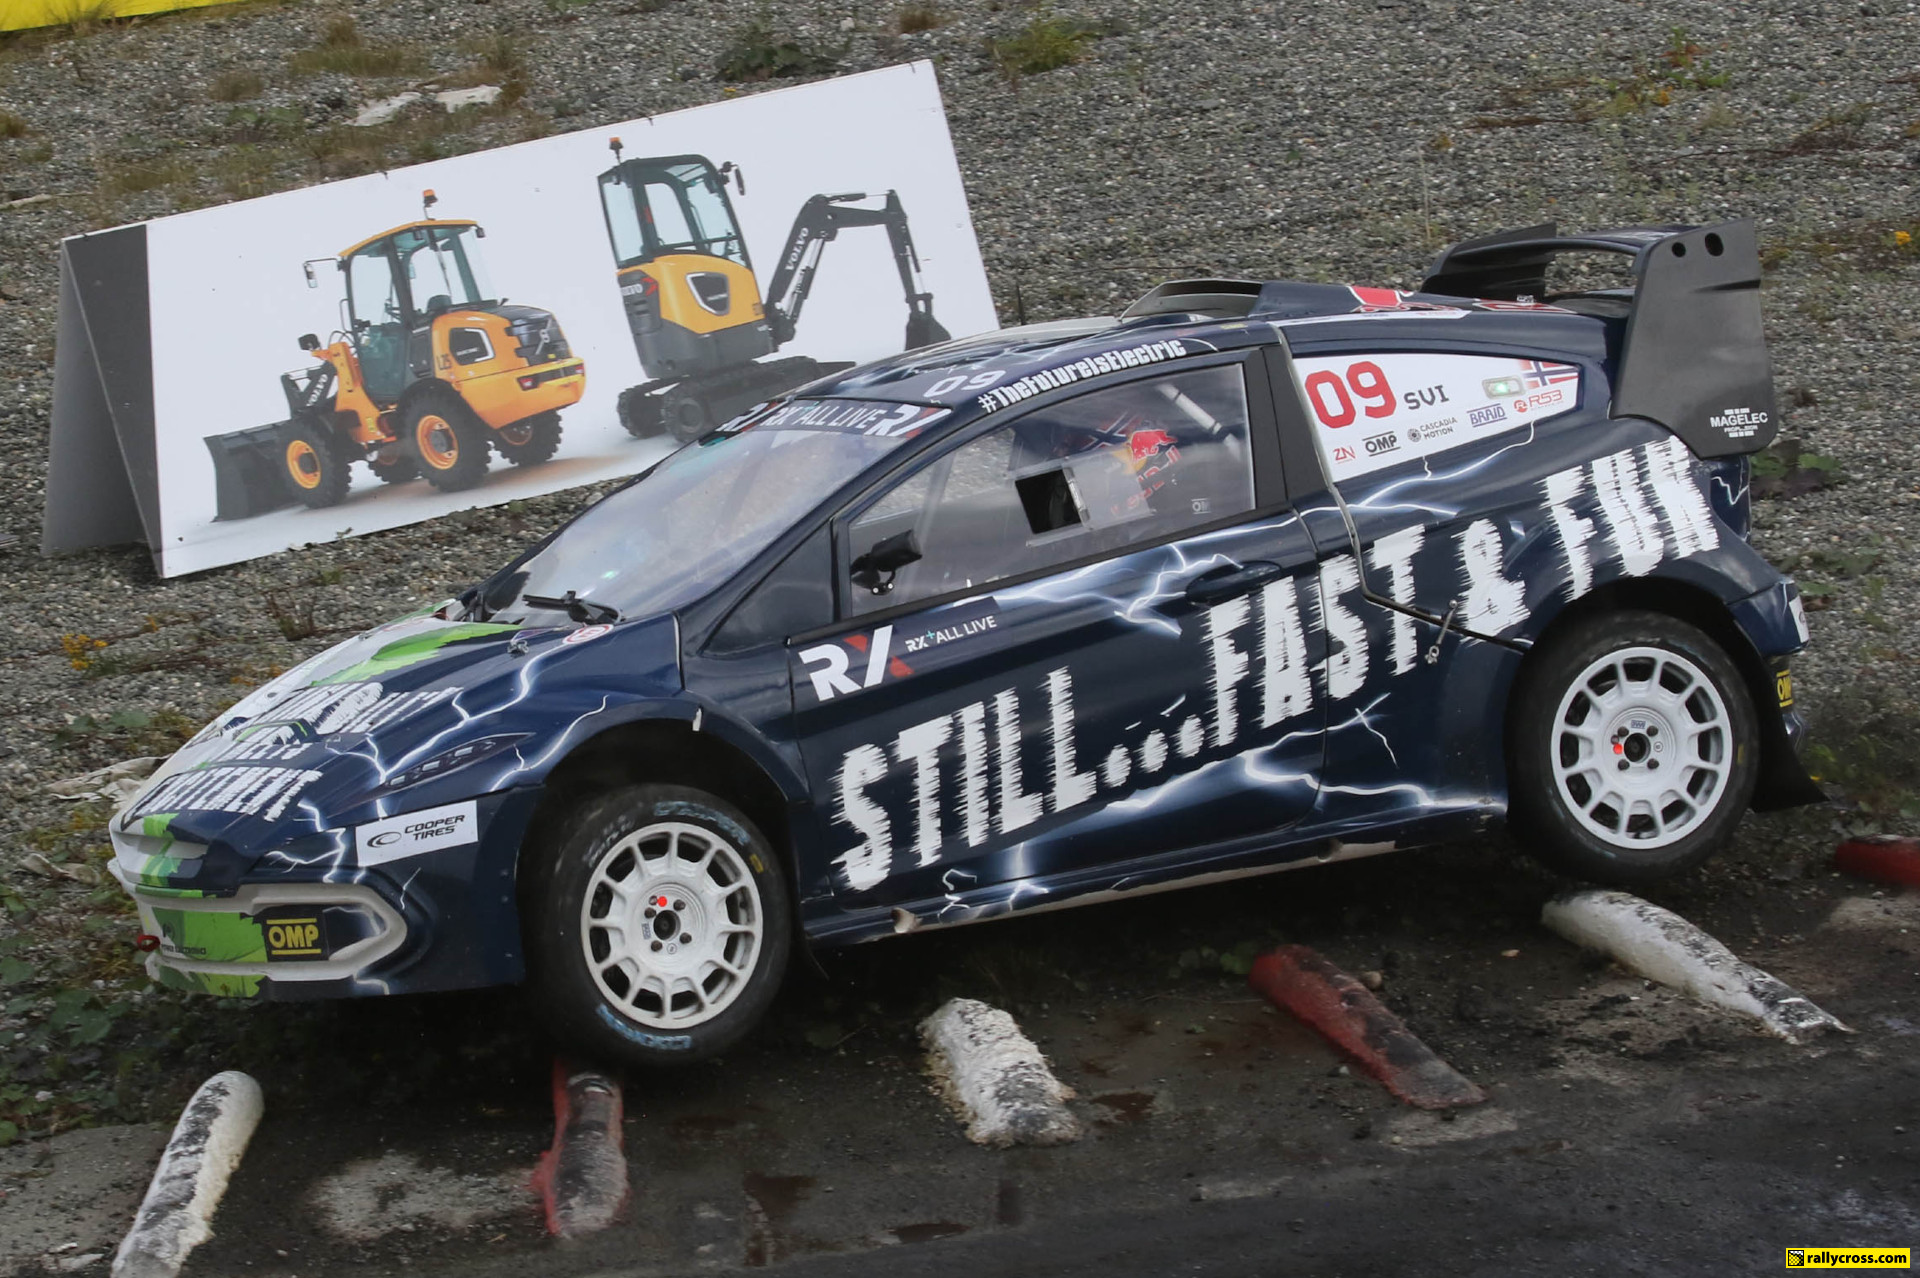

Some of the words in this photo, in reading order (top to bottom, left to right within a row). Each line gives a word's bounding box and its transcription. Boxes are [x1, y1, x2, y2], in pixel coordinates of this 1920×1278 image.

[784, 227, 809, 271] VOLVO
[923, 369, 1007, 398] 09
[977, 338, 1188, 414] #TheFutureIsElectric
[306, 374, 329, 407] VOLVO
[1304, 361, 1397, 429] 09
[1404, 384, 1450, 410] SVI
[1419, 416, 1458, 433] CASCADIA
[1470, 406, 1507, 426] BRAID
[1709, 412, 1769, 428] MAGELEC
[1364, 433, 1398, 453] OMP
[1423, 426, 1454, 441] MOTION
[1453, 520, 1532, 644] &
[1540, 434, 1722, 601] FUN
[963, 615, 998, 635] LIVE
[404, 814, 466, 834] COOPER
[412, 825, 456, 841] TIRES
[268, 923, 320, 949] OMP
